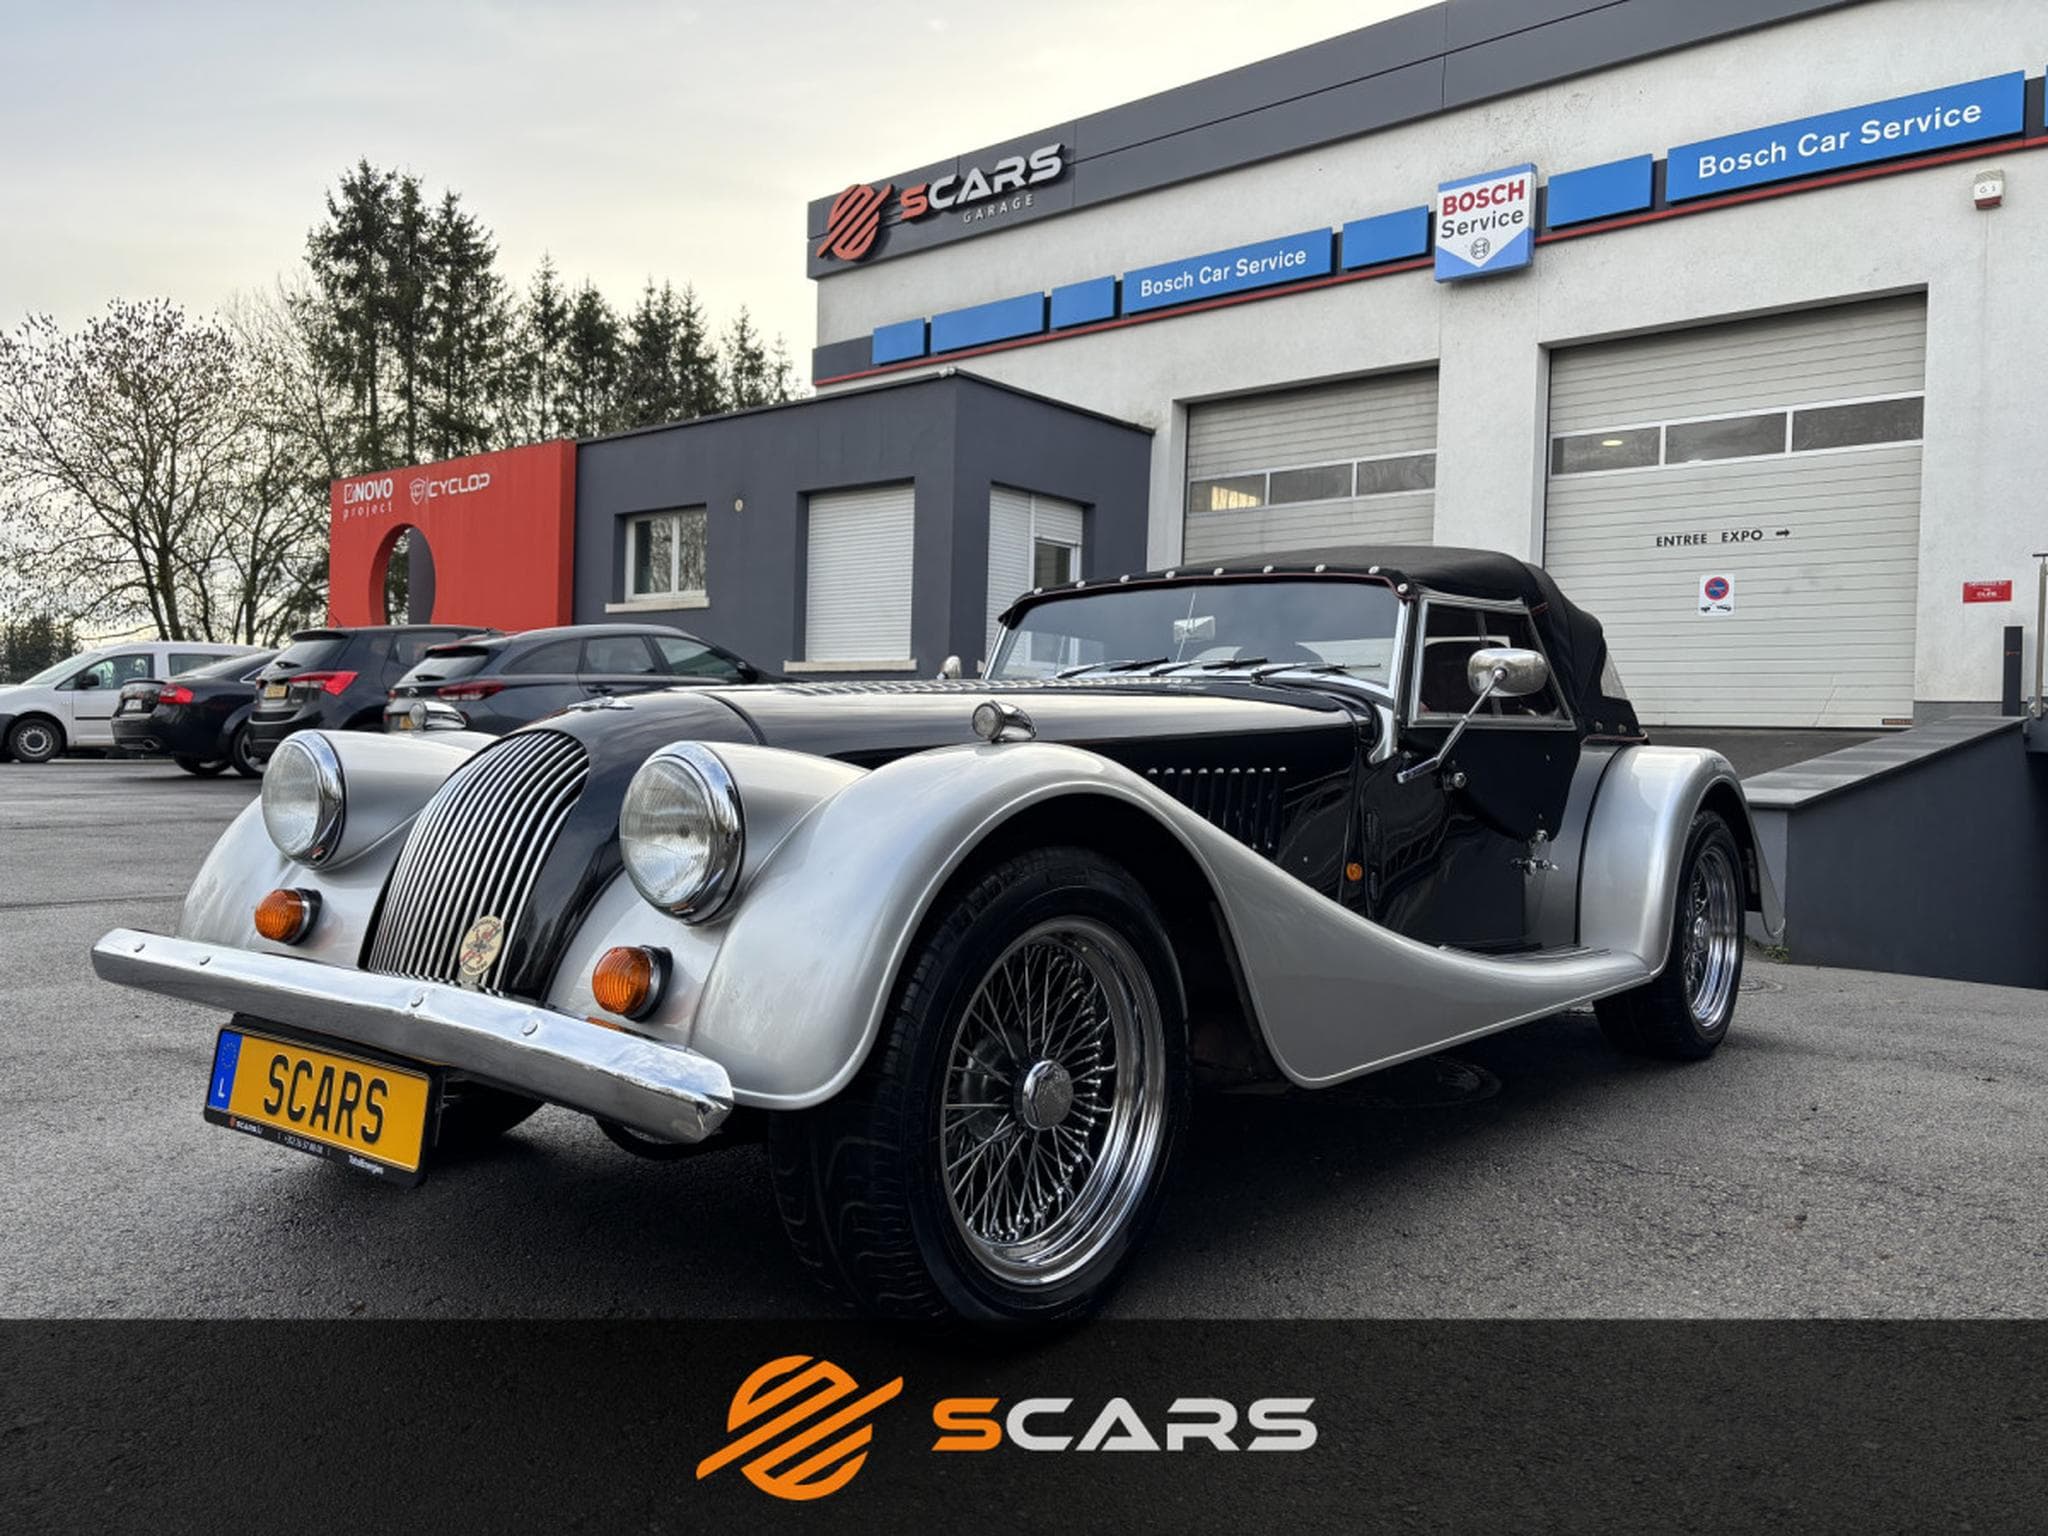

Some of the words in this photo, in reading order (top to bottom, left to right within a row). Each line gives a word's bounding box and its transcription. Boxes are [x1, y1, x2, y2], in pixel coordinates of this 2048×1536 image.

[1699, 142, 1787, 180] Bosch
[1798, 131, 1851, 157] Car
[1860, 104, 1982, 145] Service
[900, 143, 1063, 220] SCARS
[963, 194, 1034, 223] GARAGE
[1442, 179, 1525, 216] BOSCH
[1441, 209, 1524, 239] Service
[1140, 271, 1194, 297] Bosch
[1199, 266, 1230, 285] Car
[1236, 250, 1307, 277] Service
[428, 473, 491, 498] CYCLOP
[343, 502, 392, 521] project
[1656, 533, 1708, 547] ENTREE
[1721, 529, 1763, 542] EXPO
[217, 1078, 226, 1098] L
[263, 1054, 388, 1145] SCARS
